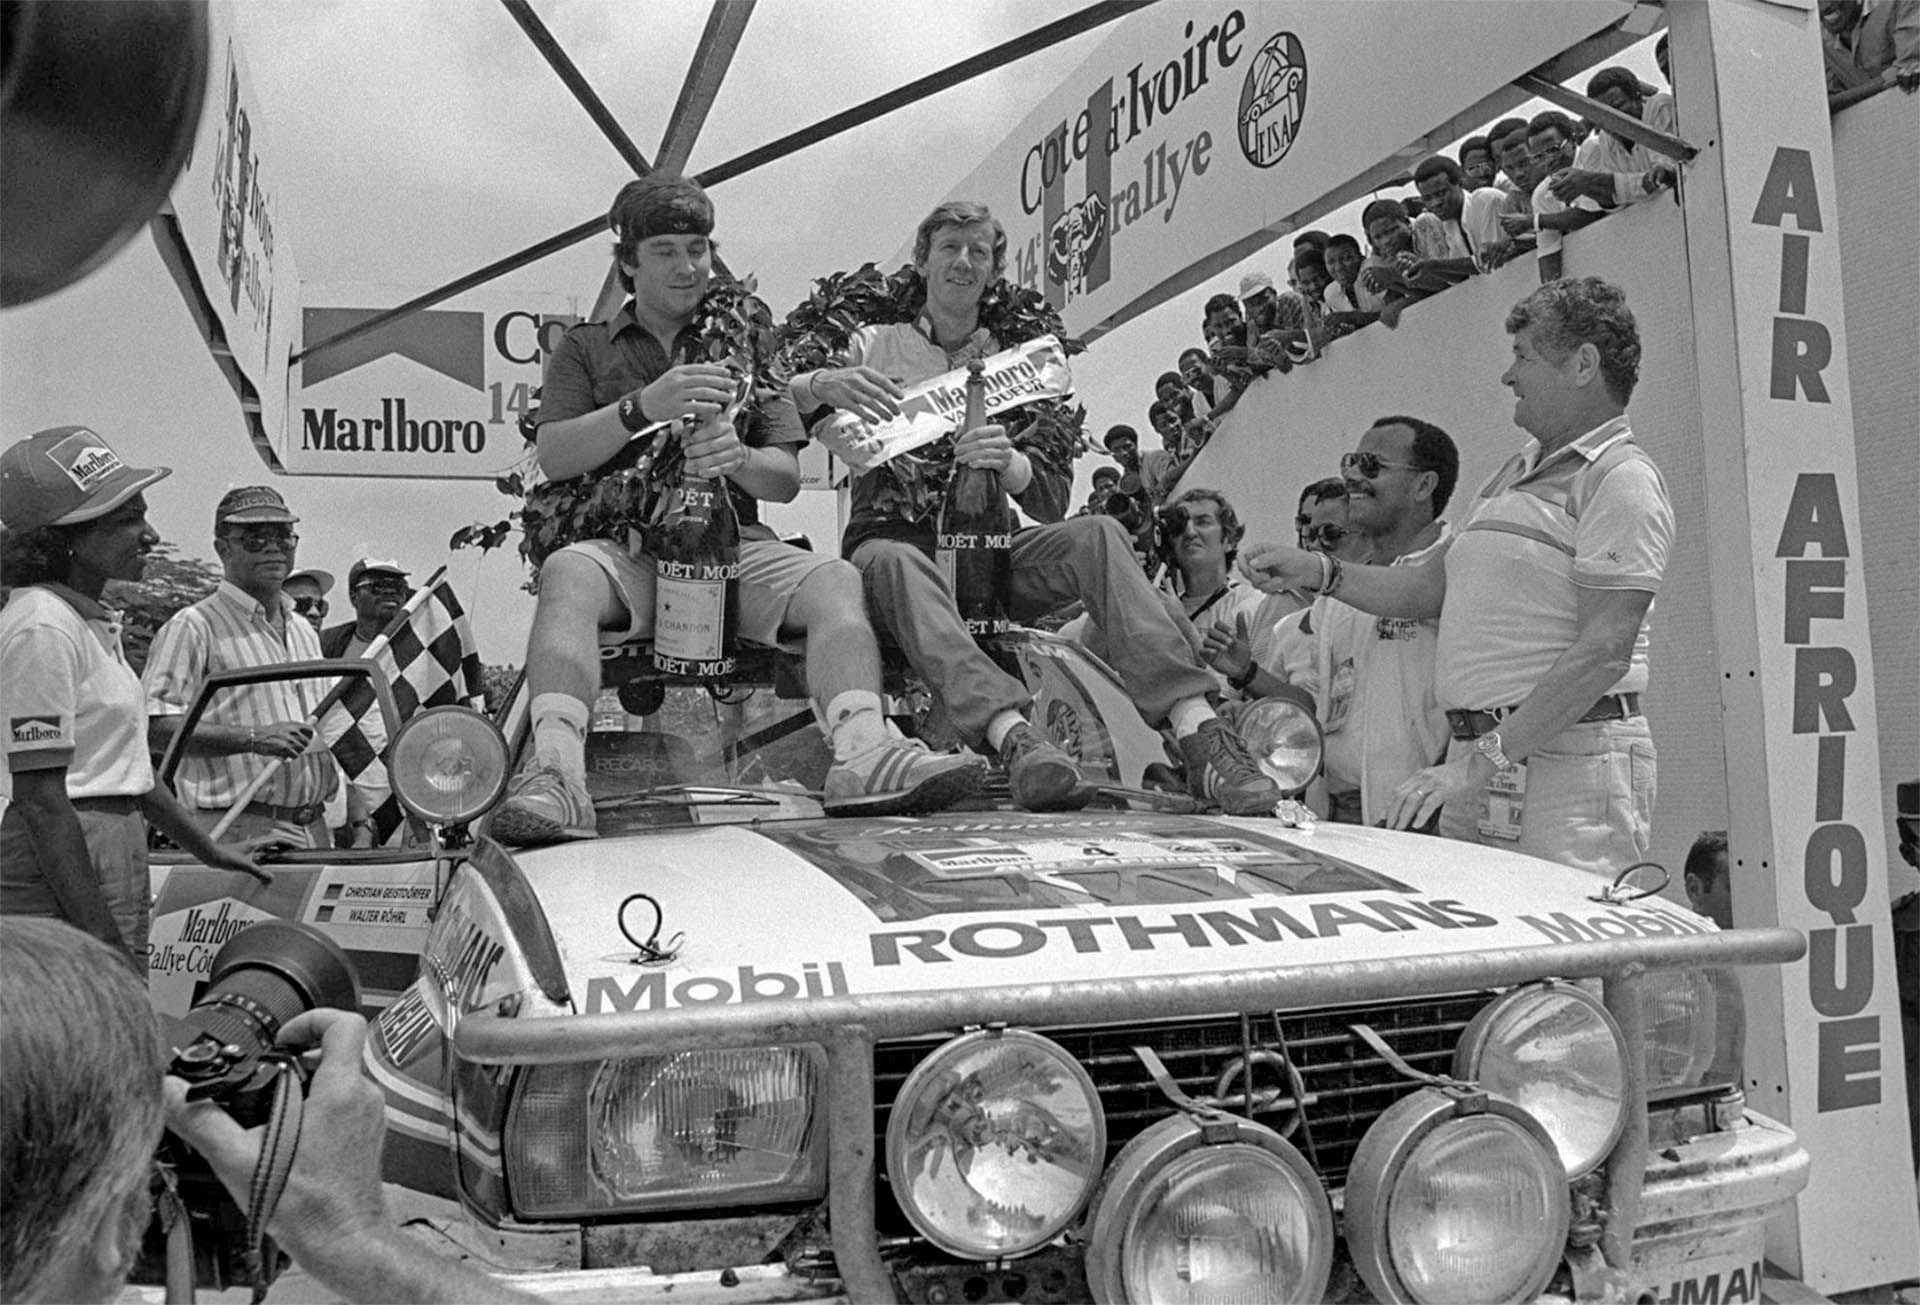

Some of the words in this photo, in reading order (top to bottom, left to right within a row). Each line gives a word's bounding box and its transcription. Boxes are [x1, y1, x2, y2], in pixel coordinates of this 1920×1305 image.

[1257, 114, 1290, 163] FISA
[1108, 130, 1212, 237] rallye
[1751, 146, 1832, 404] AIR
[301, 398, 486, 453] Marlboro
[1775, 472, 1882, 1113] AFRIQUE
[938, 856, 1033, 867] Marlboro
[345, 886, 381, 899] CHRISTIAN
[349, 909, 380, 923] WALTER
[380, 906, 408, 924] RÖHRL
[869, 899, 1498, 966] ROTHMANS
[1515, 908, 1710, 944] Mobil
[584, 961, 850, 1015] Mobil
